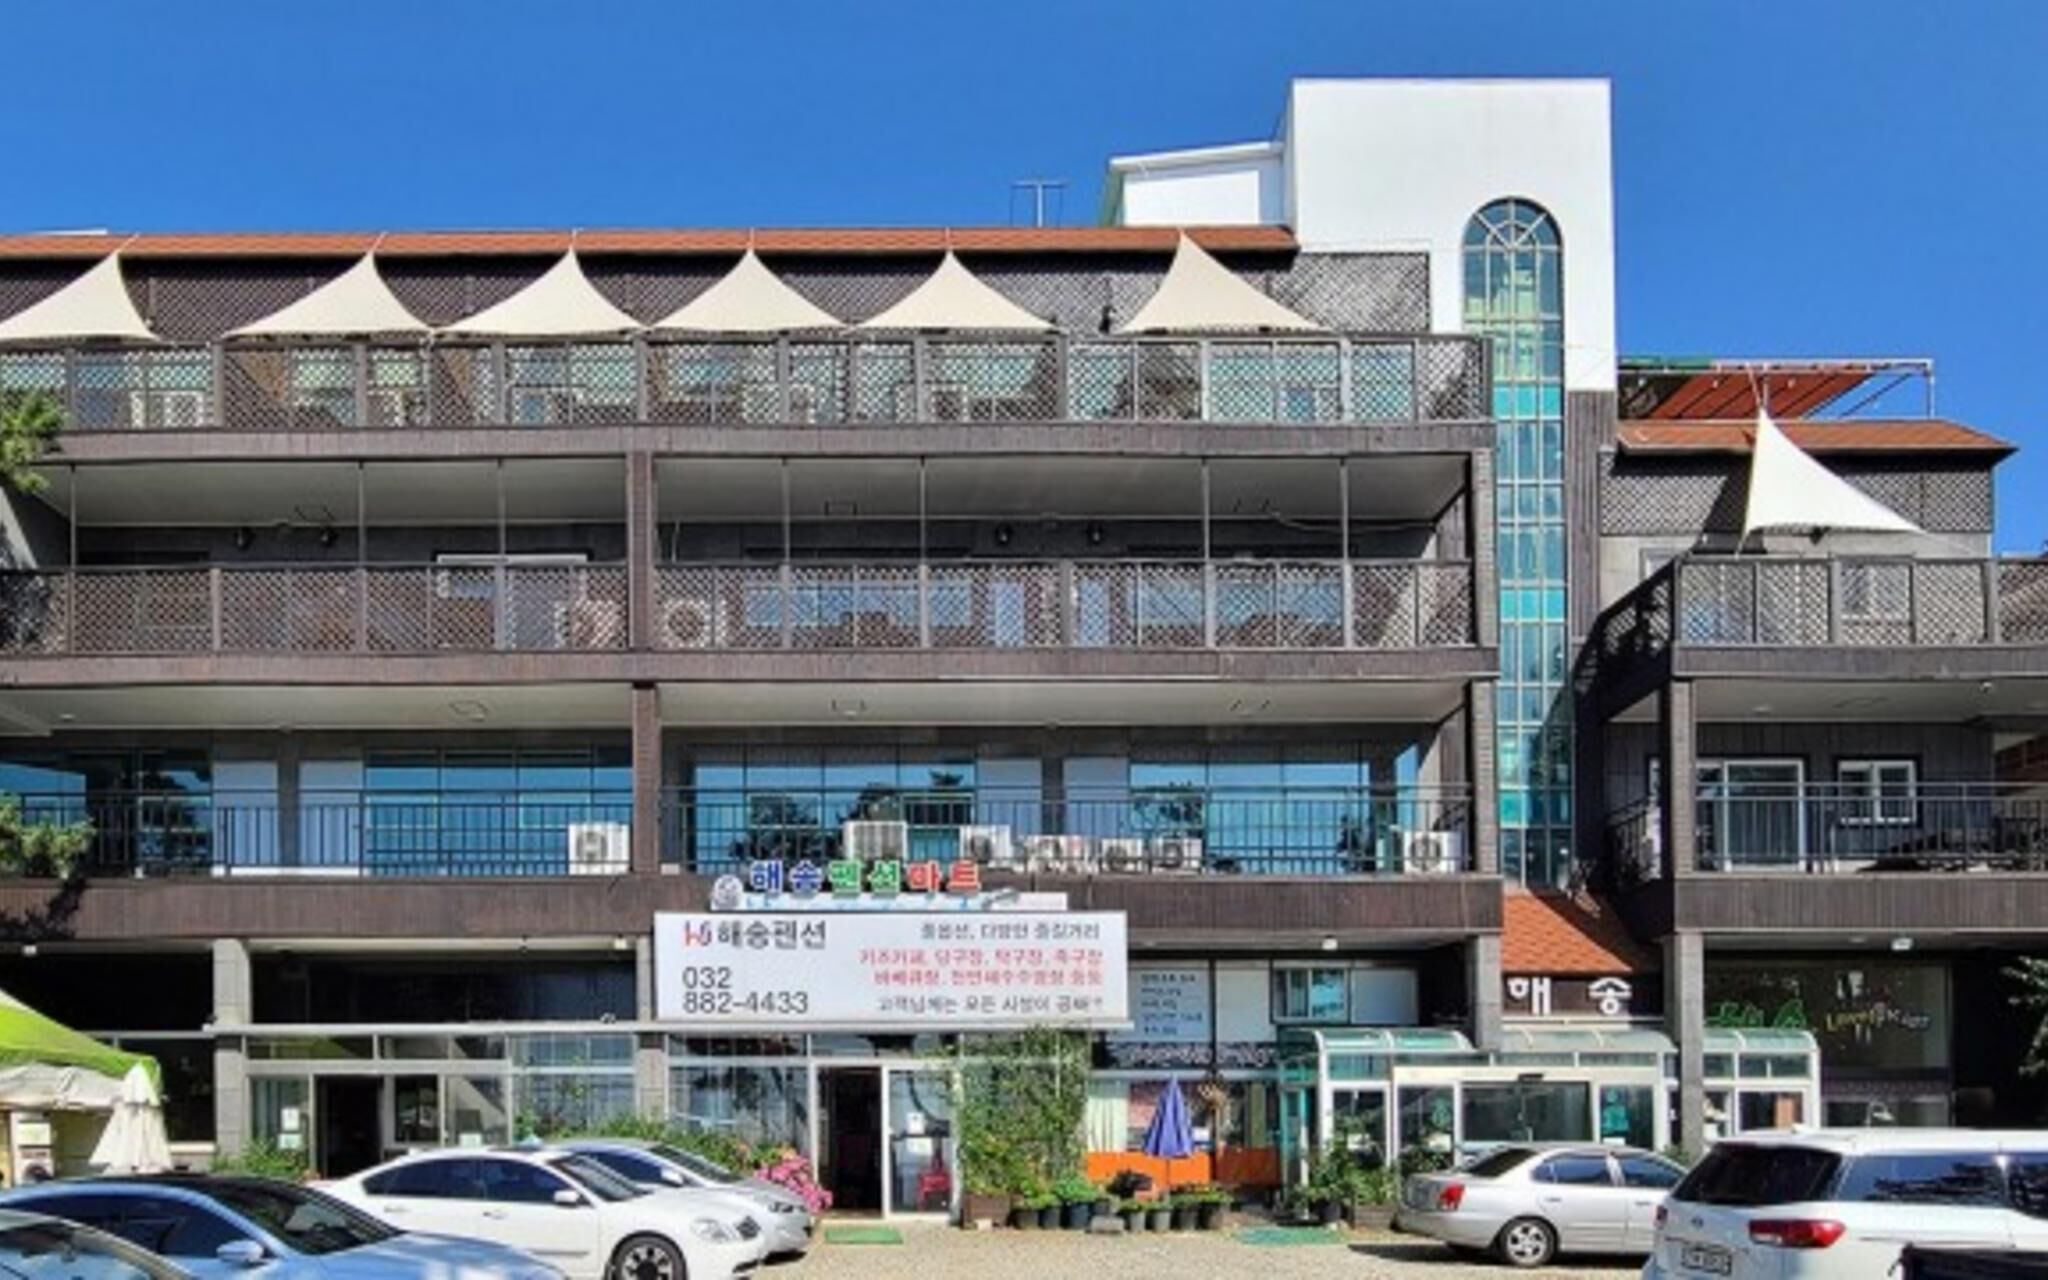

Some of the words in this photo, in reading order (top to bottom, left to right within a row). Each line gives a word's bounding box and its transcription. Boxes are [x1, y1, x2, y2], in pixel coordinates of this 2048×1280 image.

[750, 860, 981, 894] 해송펜션마트
[717, 920, 827, 950] 해송펜션
[682, 966, 732, 989] 032
[682, 991, 809, 1014] 882-4433
